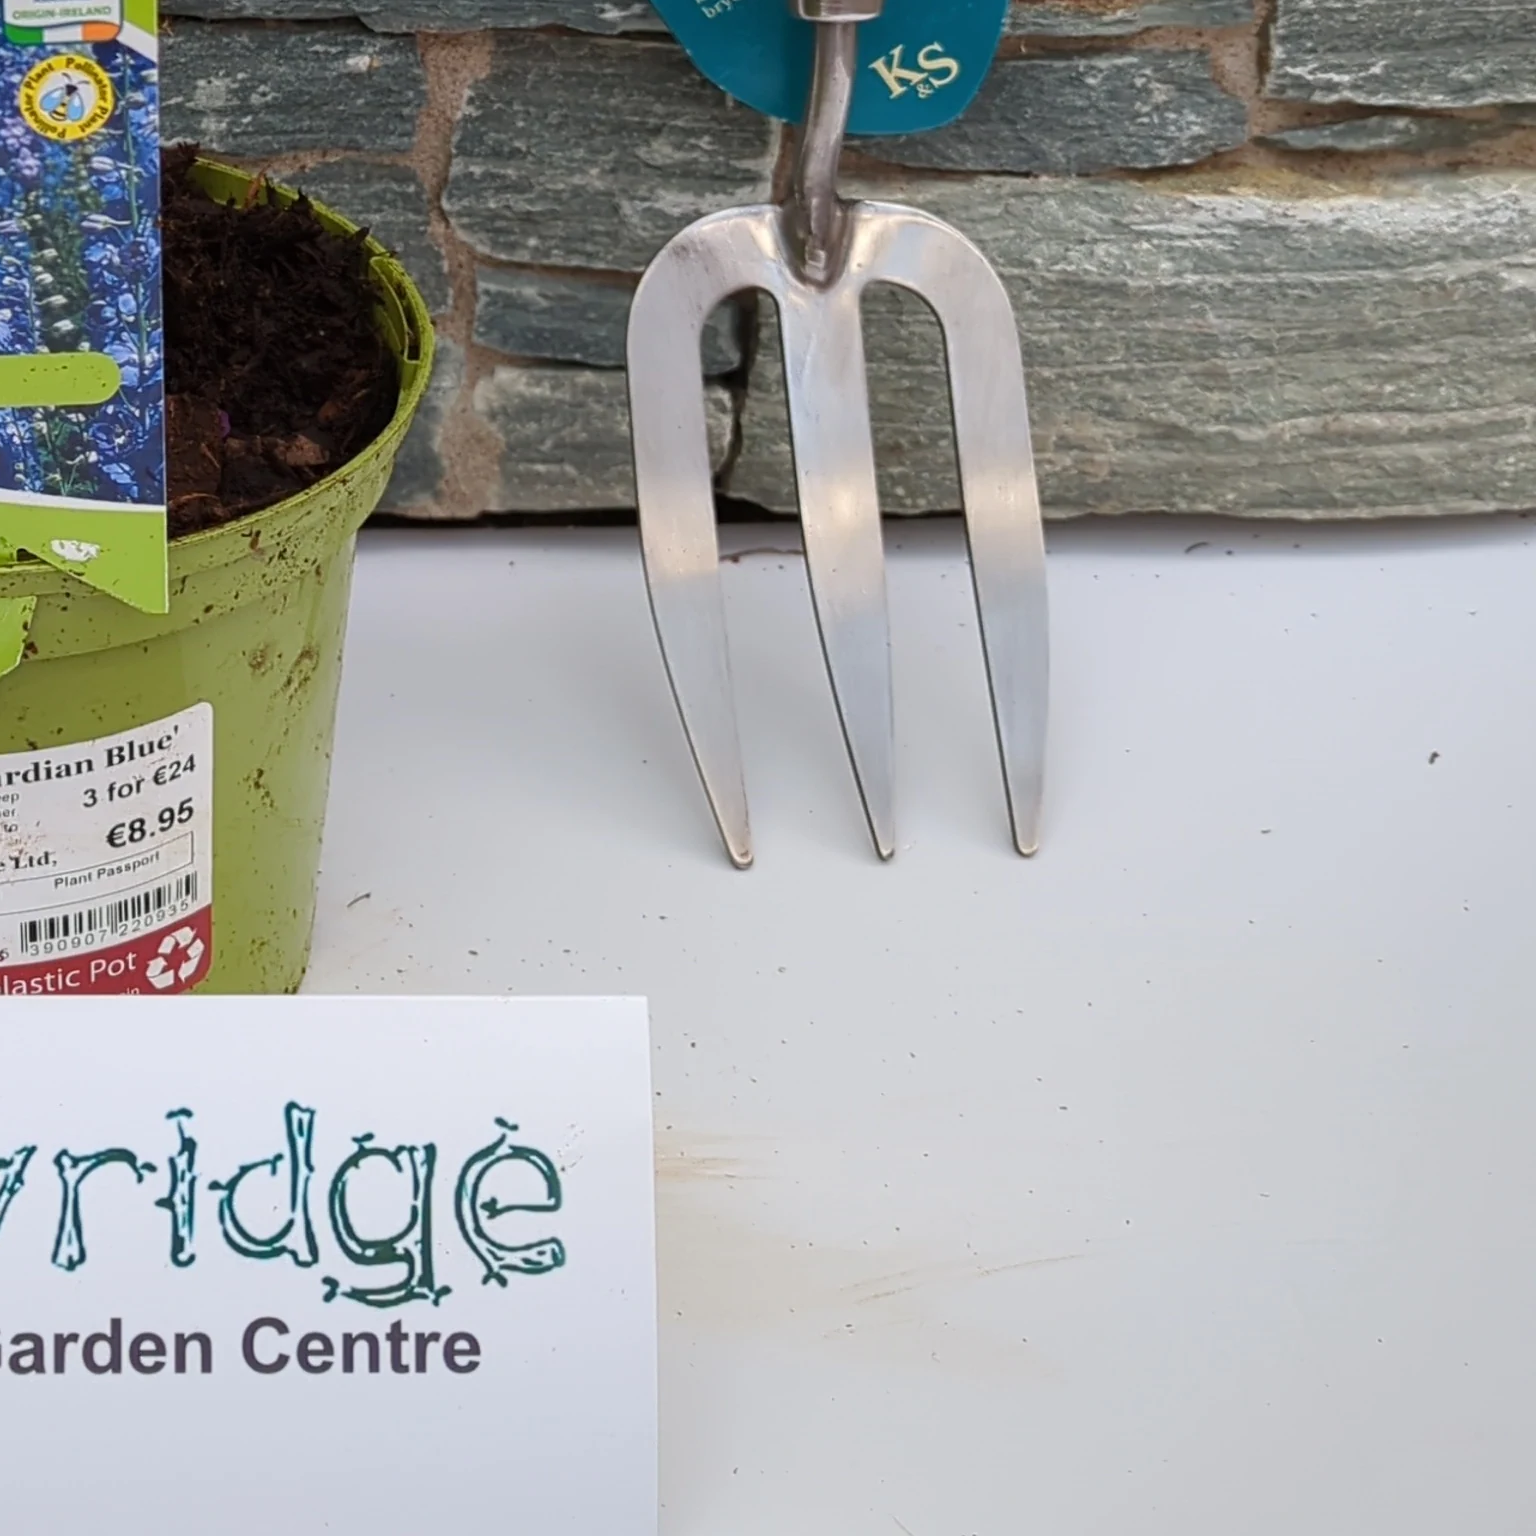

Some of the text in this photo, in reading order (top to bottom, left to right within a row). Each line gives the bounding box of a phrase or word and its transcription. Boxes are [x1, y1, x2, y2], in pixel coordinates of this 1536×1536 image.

[105, 724, 180, 768] Blue'
[82, 753, 197, 809] 3 for €24
[2, 822, 19, 834] to
[105, 796, 195, 849] €8.95
[53, 850, 160, 889] Plant Passport
[29, 928, 108, 957] 390907
[118, 900, 189, 937] 220935
[89, 951, 138, 983] Pot
[241, 1316, 482, 1376] Centre
